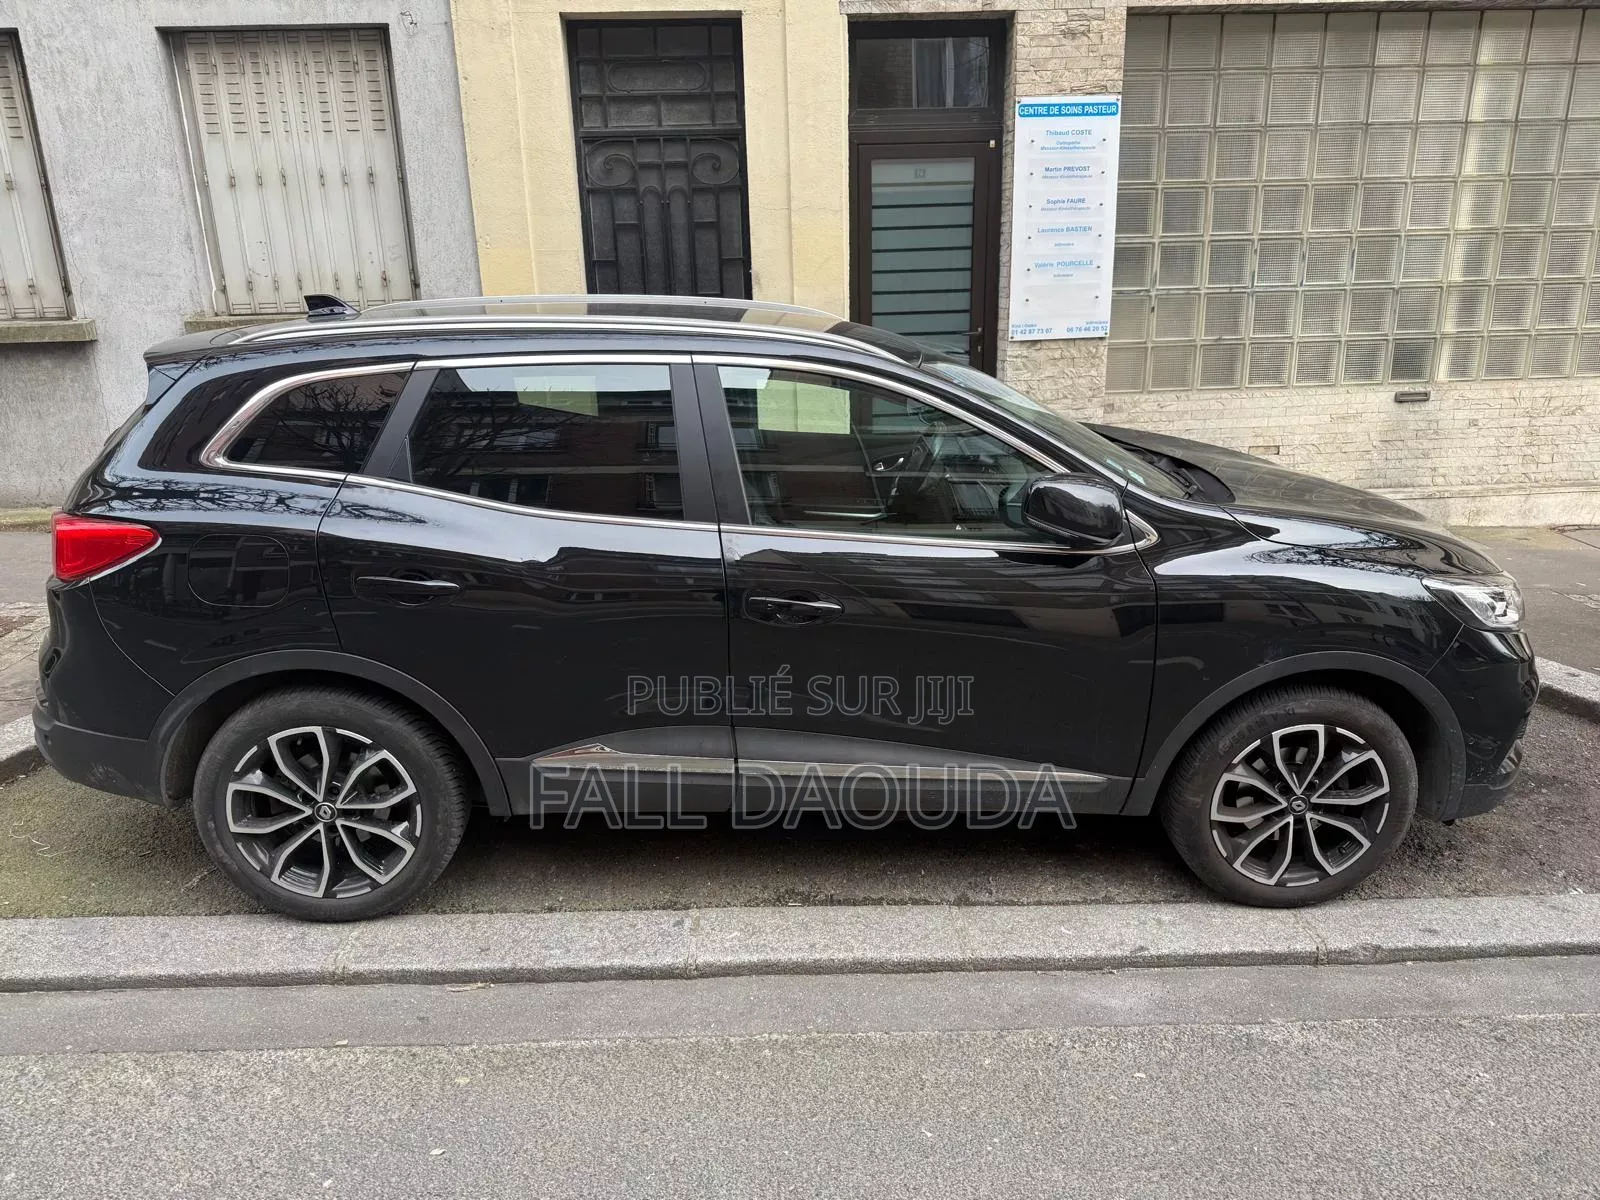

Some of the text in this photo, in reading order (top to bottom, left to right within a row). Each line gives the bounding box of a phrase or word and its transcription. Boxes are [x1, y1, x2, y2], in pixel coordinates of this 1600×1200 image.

[1019, 104, 1117, 115] CENTRE DE SOINS PASTEUR
